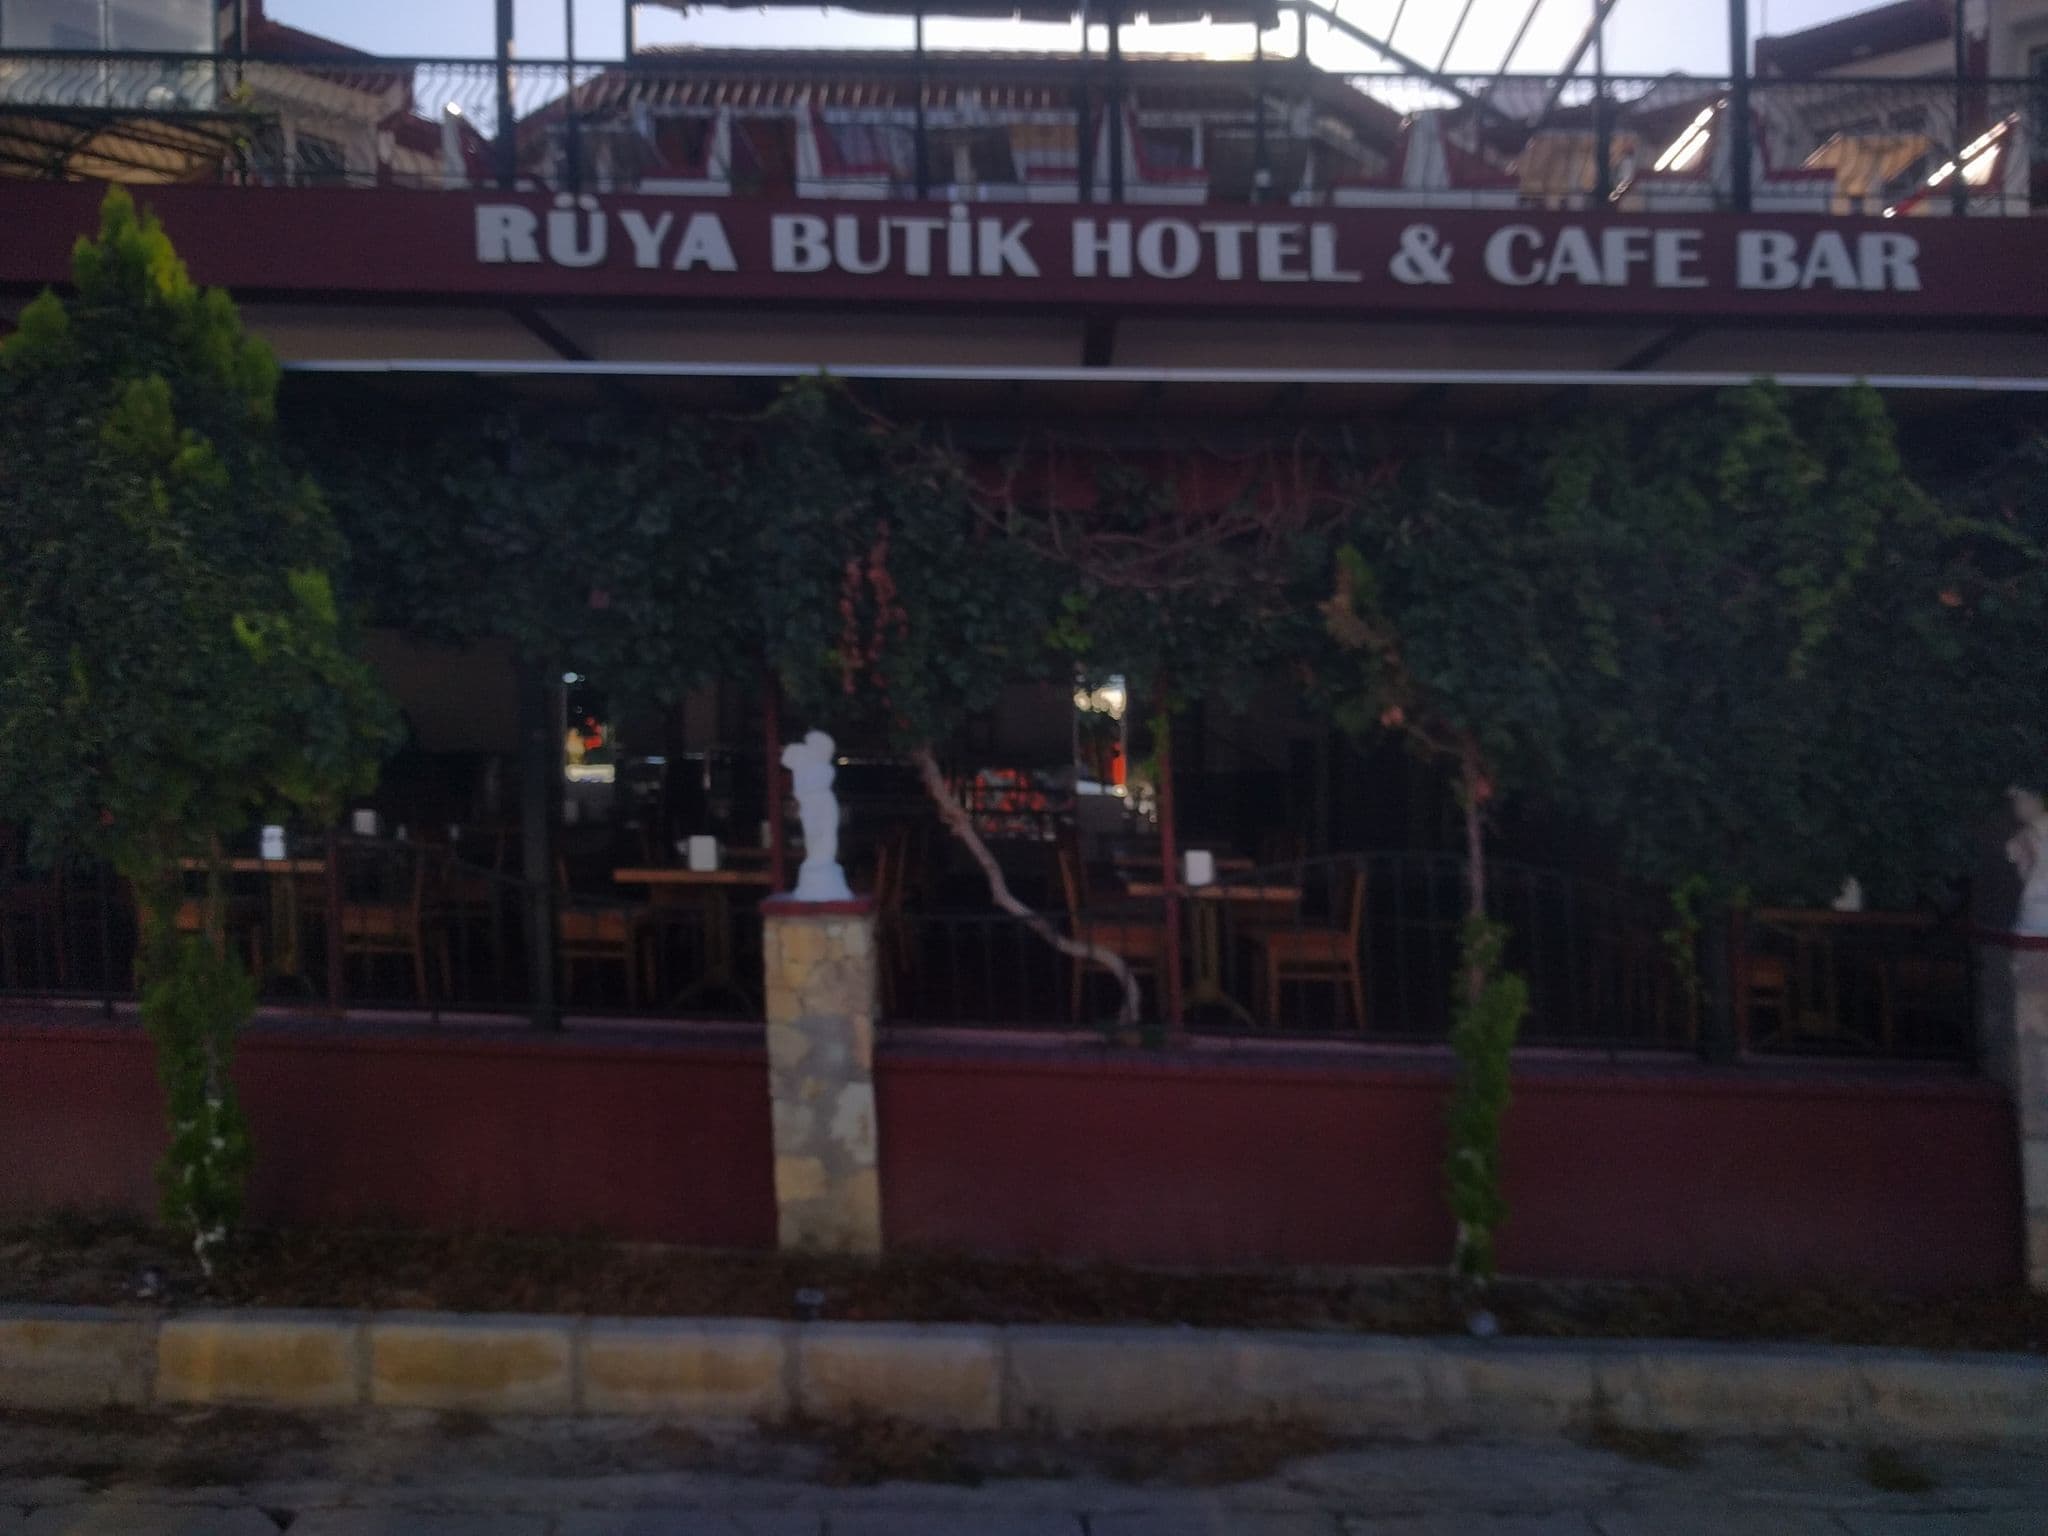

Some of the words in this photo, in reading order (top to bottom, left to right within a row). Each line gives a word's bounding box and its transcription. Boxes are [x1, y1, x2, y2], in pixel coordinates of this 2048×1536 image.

[475, 194, 738, 271] RÜYA
[771, 203, 1041, 277] BUTİK
[1072, 219, 1362, 283] HOTEL
[1390, 223, 1453, 285] &
[1485, 224, 1707, 288] CAFE
[1737, 230, 1921, 291] BAR
